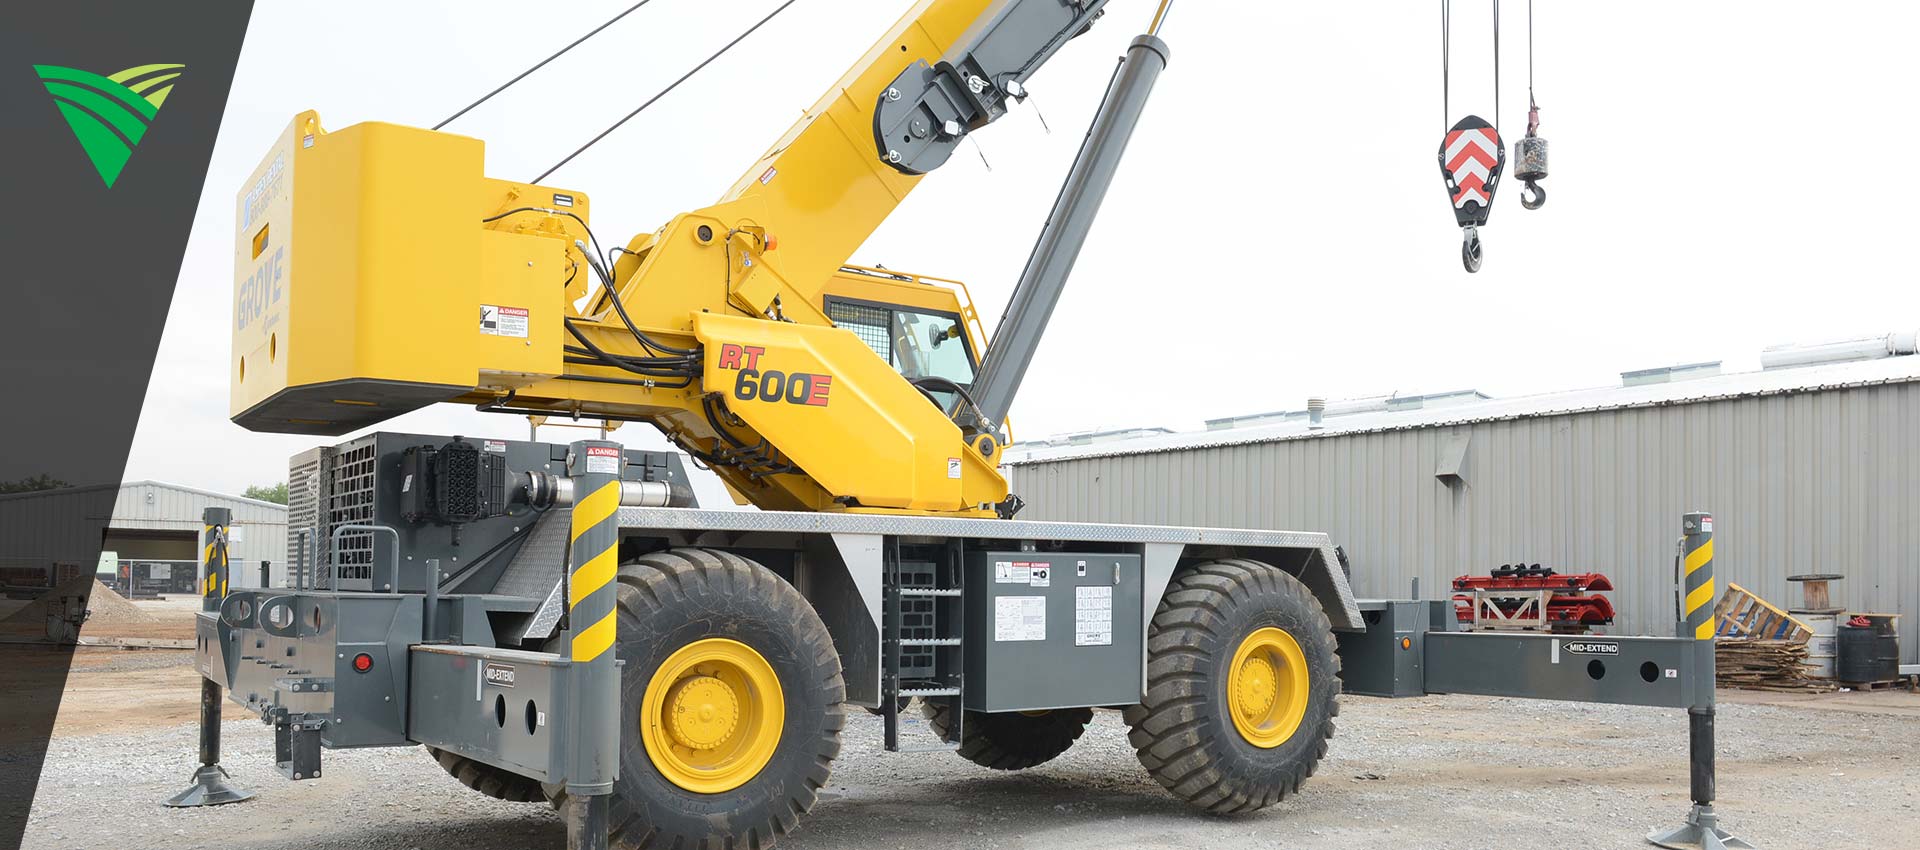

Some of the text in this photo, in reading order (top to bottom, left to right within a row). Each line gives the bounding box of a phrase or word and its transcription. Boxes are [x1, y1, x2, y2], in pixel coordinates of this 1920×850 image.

[238, 245, 283, 331] GROVE
[504, 308, 528, 316] DANGER
[718, 343, 765, 370] RT
[734, 368, 832, 407] 600E
[594, 448, 618, 457] DANGER
[1570, 644, 1617, 652] MID-EXTEND
[486, 668, 514, 682] MID-EXTEND
